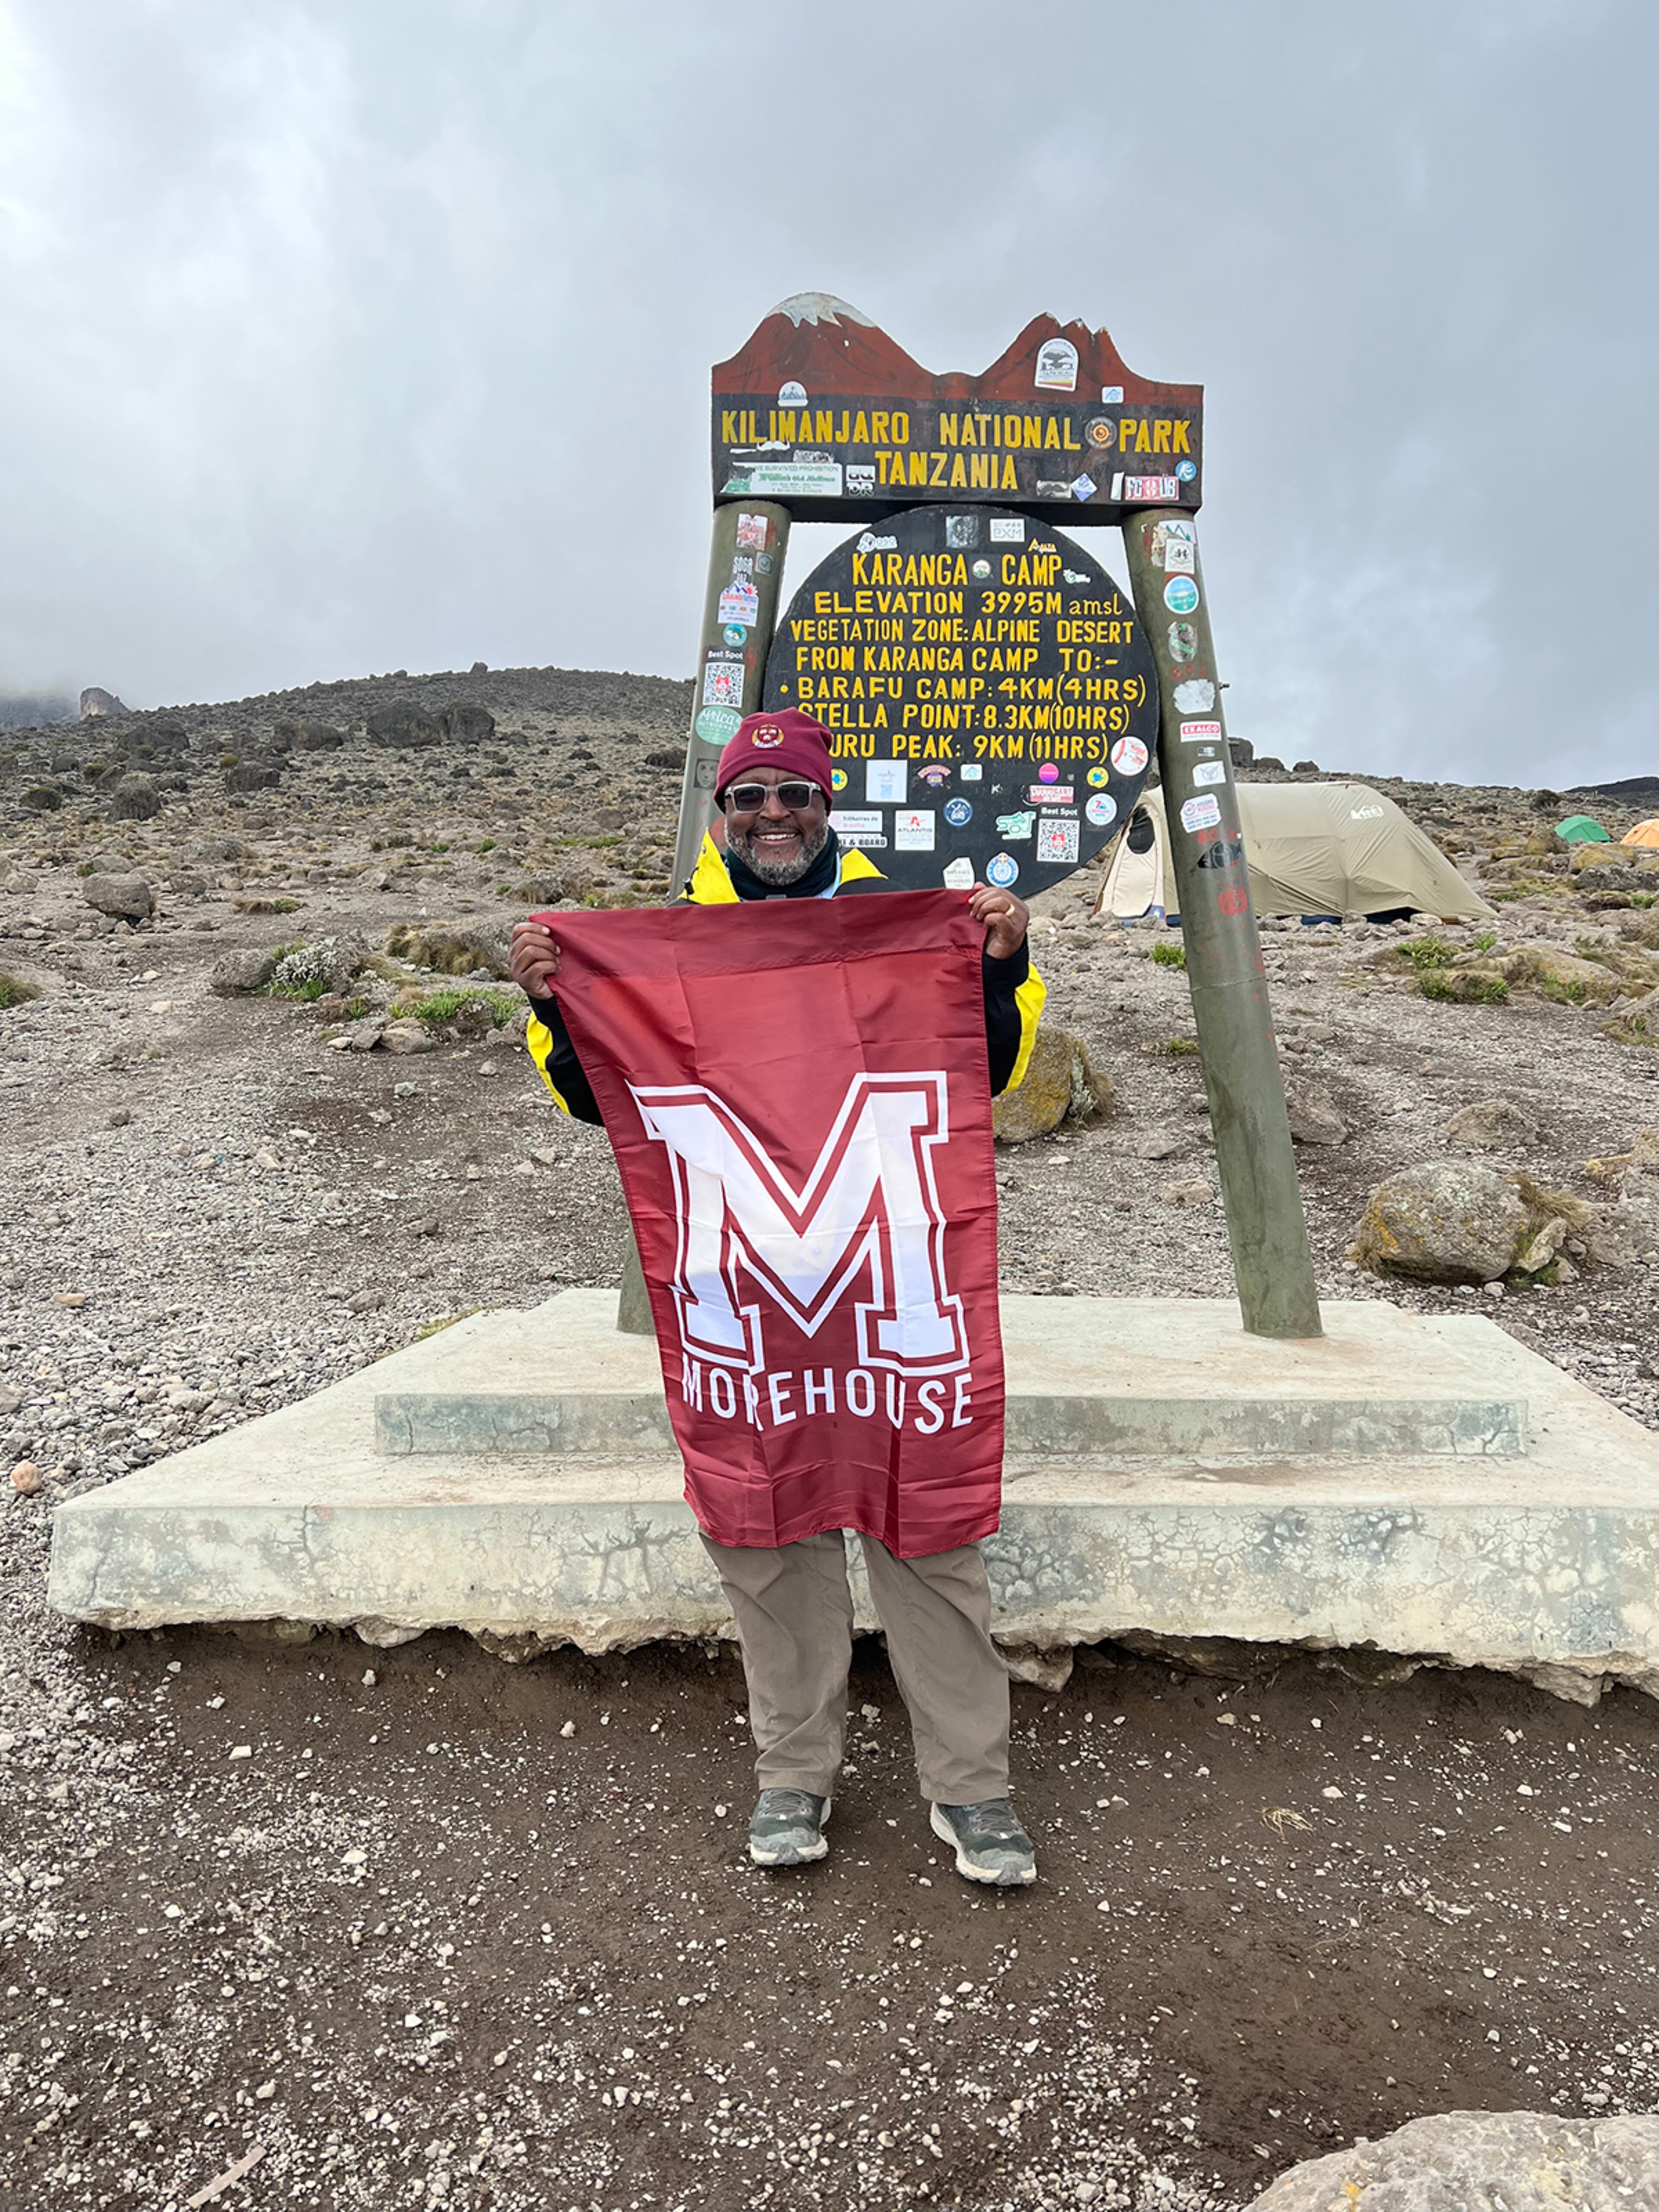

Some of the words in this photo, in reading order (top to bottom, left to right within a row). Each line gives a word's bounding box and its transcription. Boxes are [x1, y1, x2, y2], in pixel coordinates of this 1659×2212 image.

[722, 410, 909, 445] KILIMANJARO
[940, 413, 1081, 450] NATIONAL
[1119, 419, 1191, 454] PARK
[874, 451, 1018, 490] TANZANIA
[852, 553, 968, 587] KARANGA
[1001, 554, 1062, 586] CAMP
[814, 590, 963, 614] ELEVATION
[981, 591, 1062, 615] 3995M
[1069, 593, 1122, 616] amsl
[790, 618, 904, 642] VEGETATION
[1056, 620, 1134, 644] DESERT
[796, 646, 855, 671] FROM
[864, 646, 964, 672] KARANGA
[972, 648, 1039, 672] CAMP
[797, 677, 903, 699] BARAFU
[828, 734, 875, 758] URU
[892, 734, 961, 759] PEAK:
[1060, 807, 1078, 817] Spot
[625, 1071, 970, 1375] M
[682, 1352, 975, 1434] MOREHOUSE
